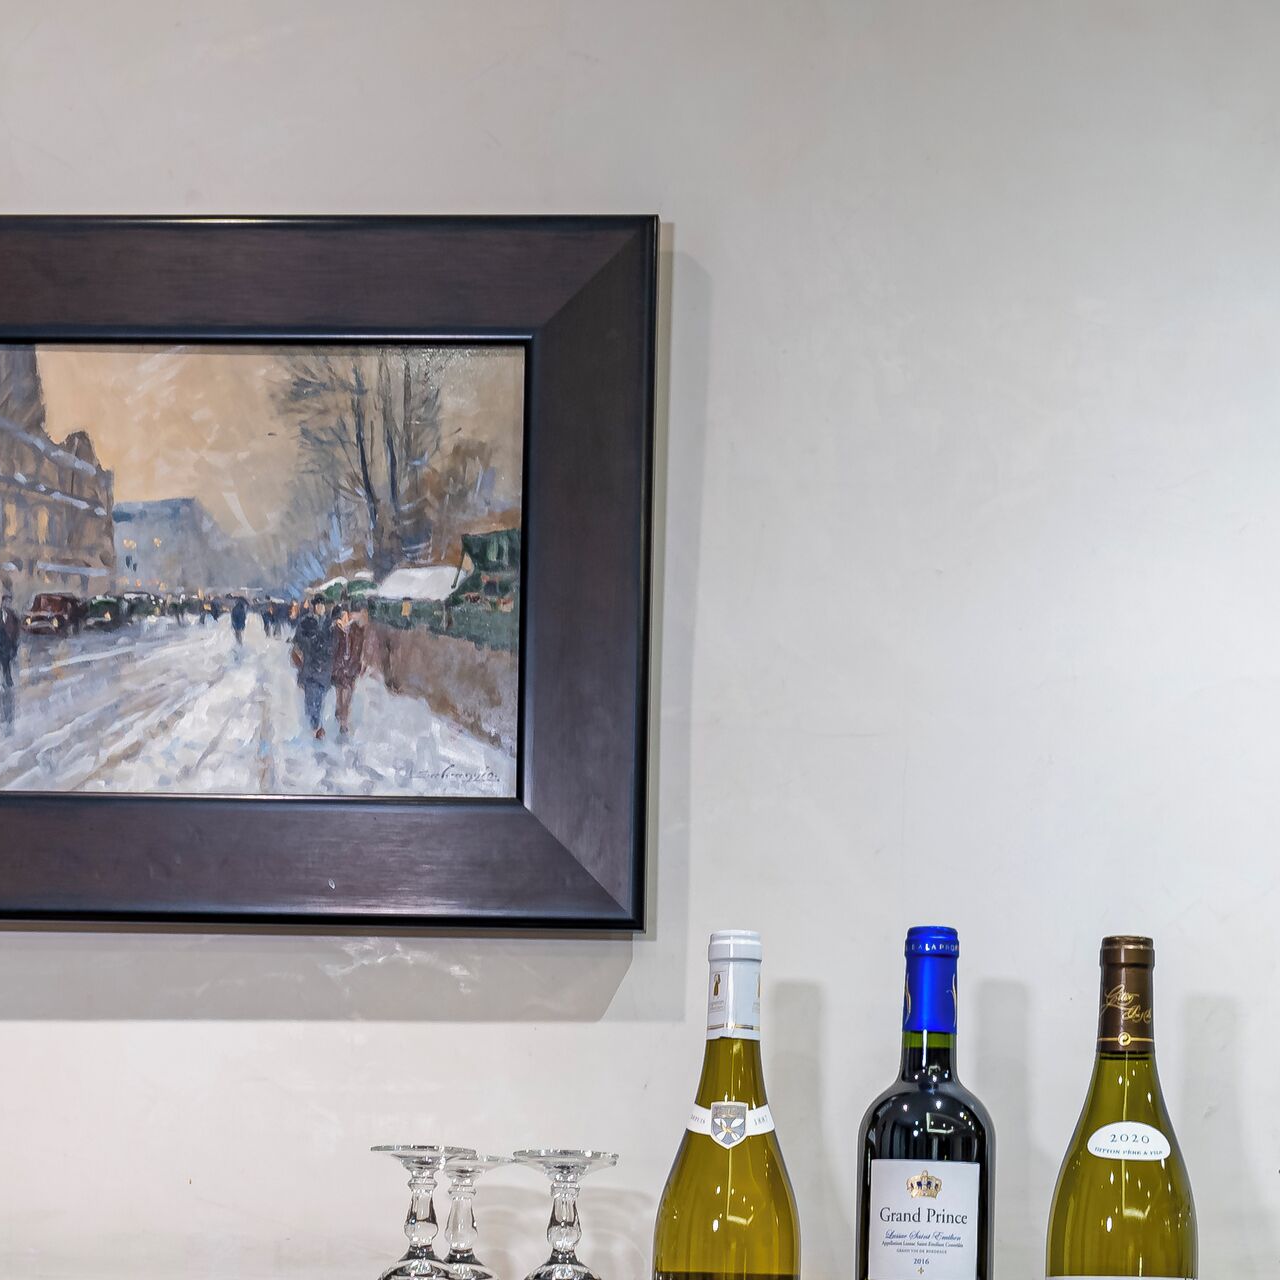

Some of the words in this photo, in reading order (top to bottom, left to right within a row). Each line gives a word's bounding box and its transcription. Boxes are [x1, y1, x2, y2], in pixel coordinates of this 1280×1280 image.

[1109, 1133, 1150, 1144] 2020
[879, 1206, 921, 1223] Grand
[926, 1208, 968, 1225] Prince
